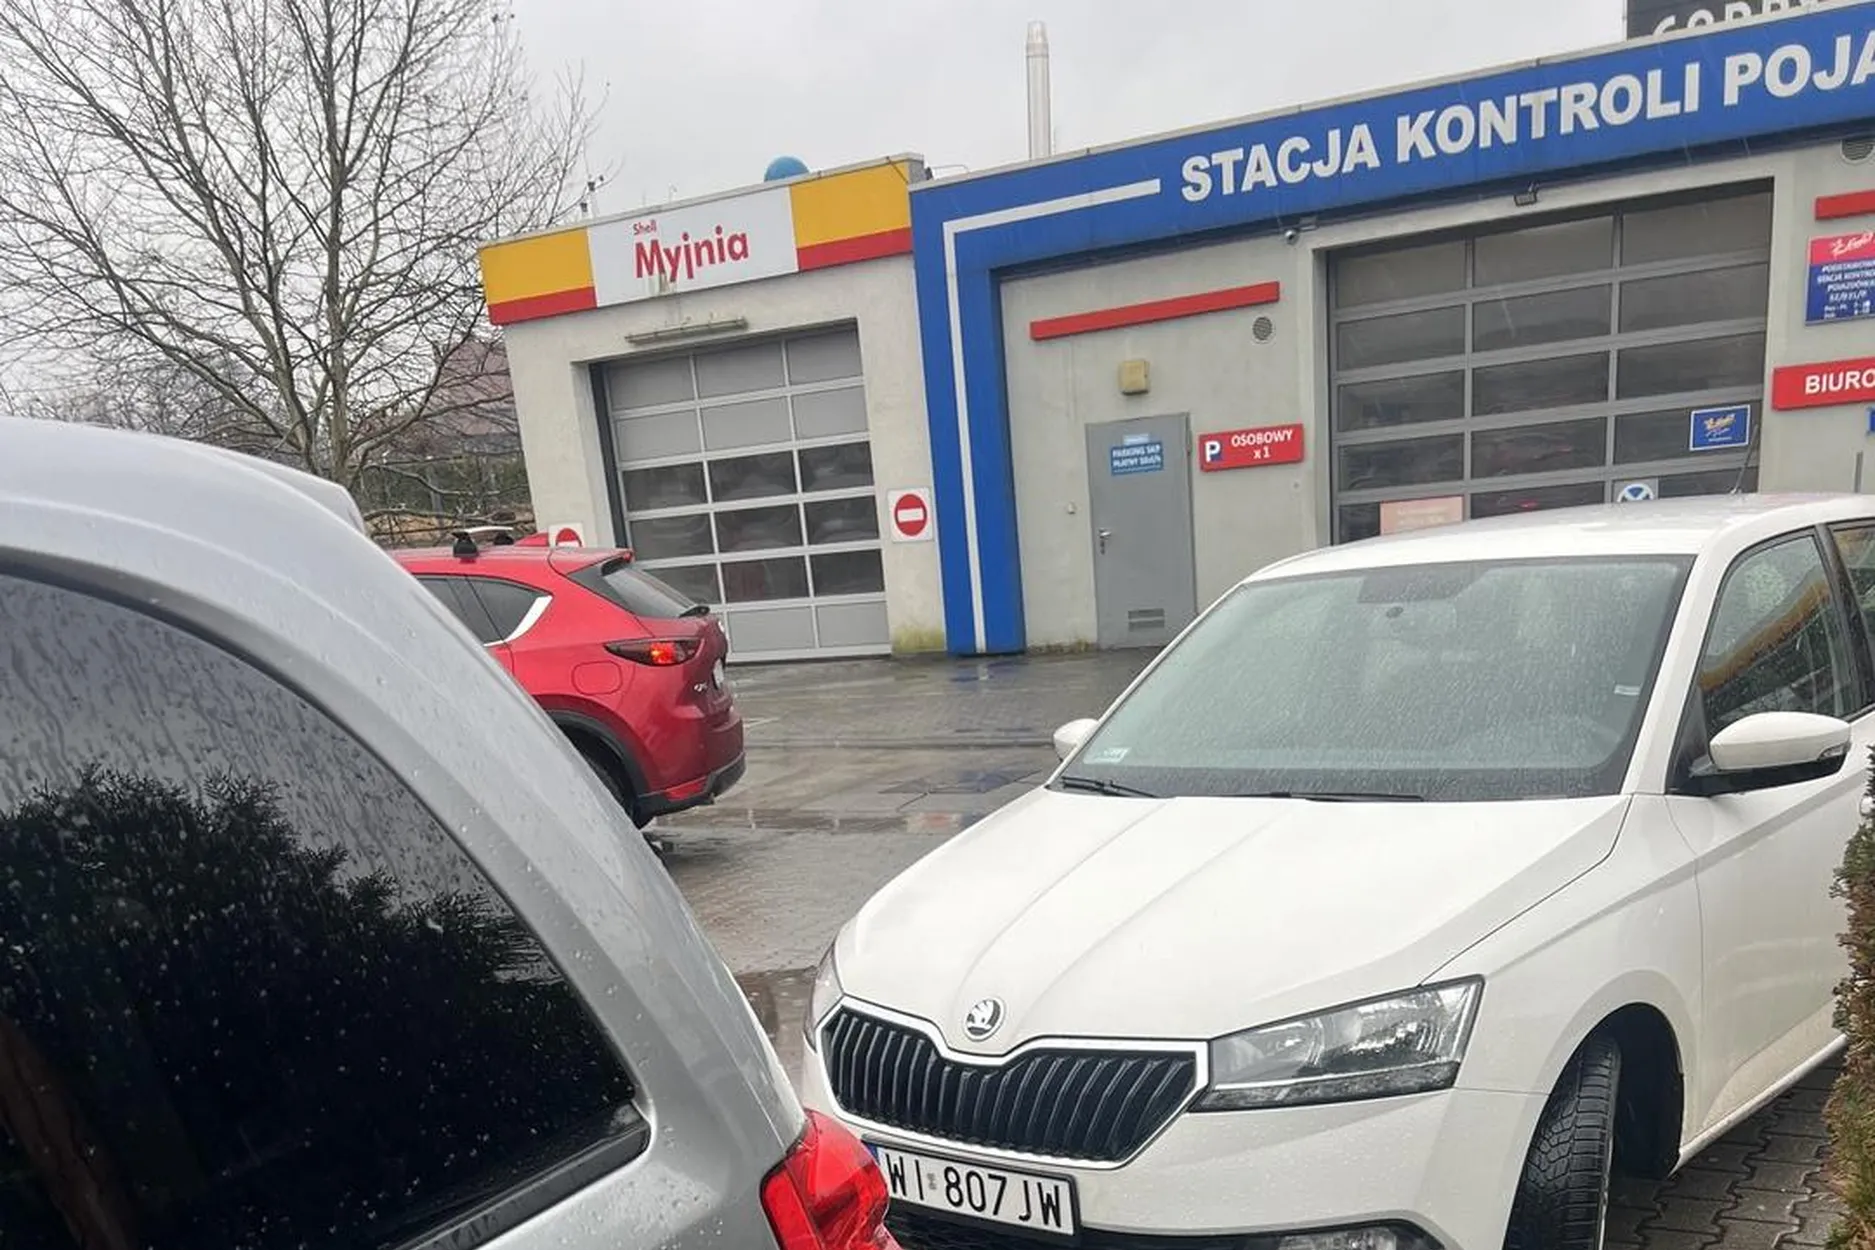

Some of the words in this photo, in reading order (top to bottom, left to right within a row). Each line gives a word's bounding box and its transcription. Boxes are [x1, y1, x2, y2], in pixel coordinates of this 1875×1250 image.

[1181, 123, 1380, 202] STACJA
[1396, 62, 1700, 164] KONTROLI
[632, 219, 657, 236] Shell
[635, 224, 749, 283] Myjnia
[1805, 368, 1875, 395] BIURO
[1231, 429, 1293, 448] OSOBOWY
[1204, 441, 1221, 462] P
[1263, 446, 1271, 459] 1
[885, 1153, 925, 1201] WI
